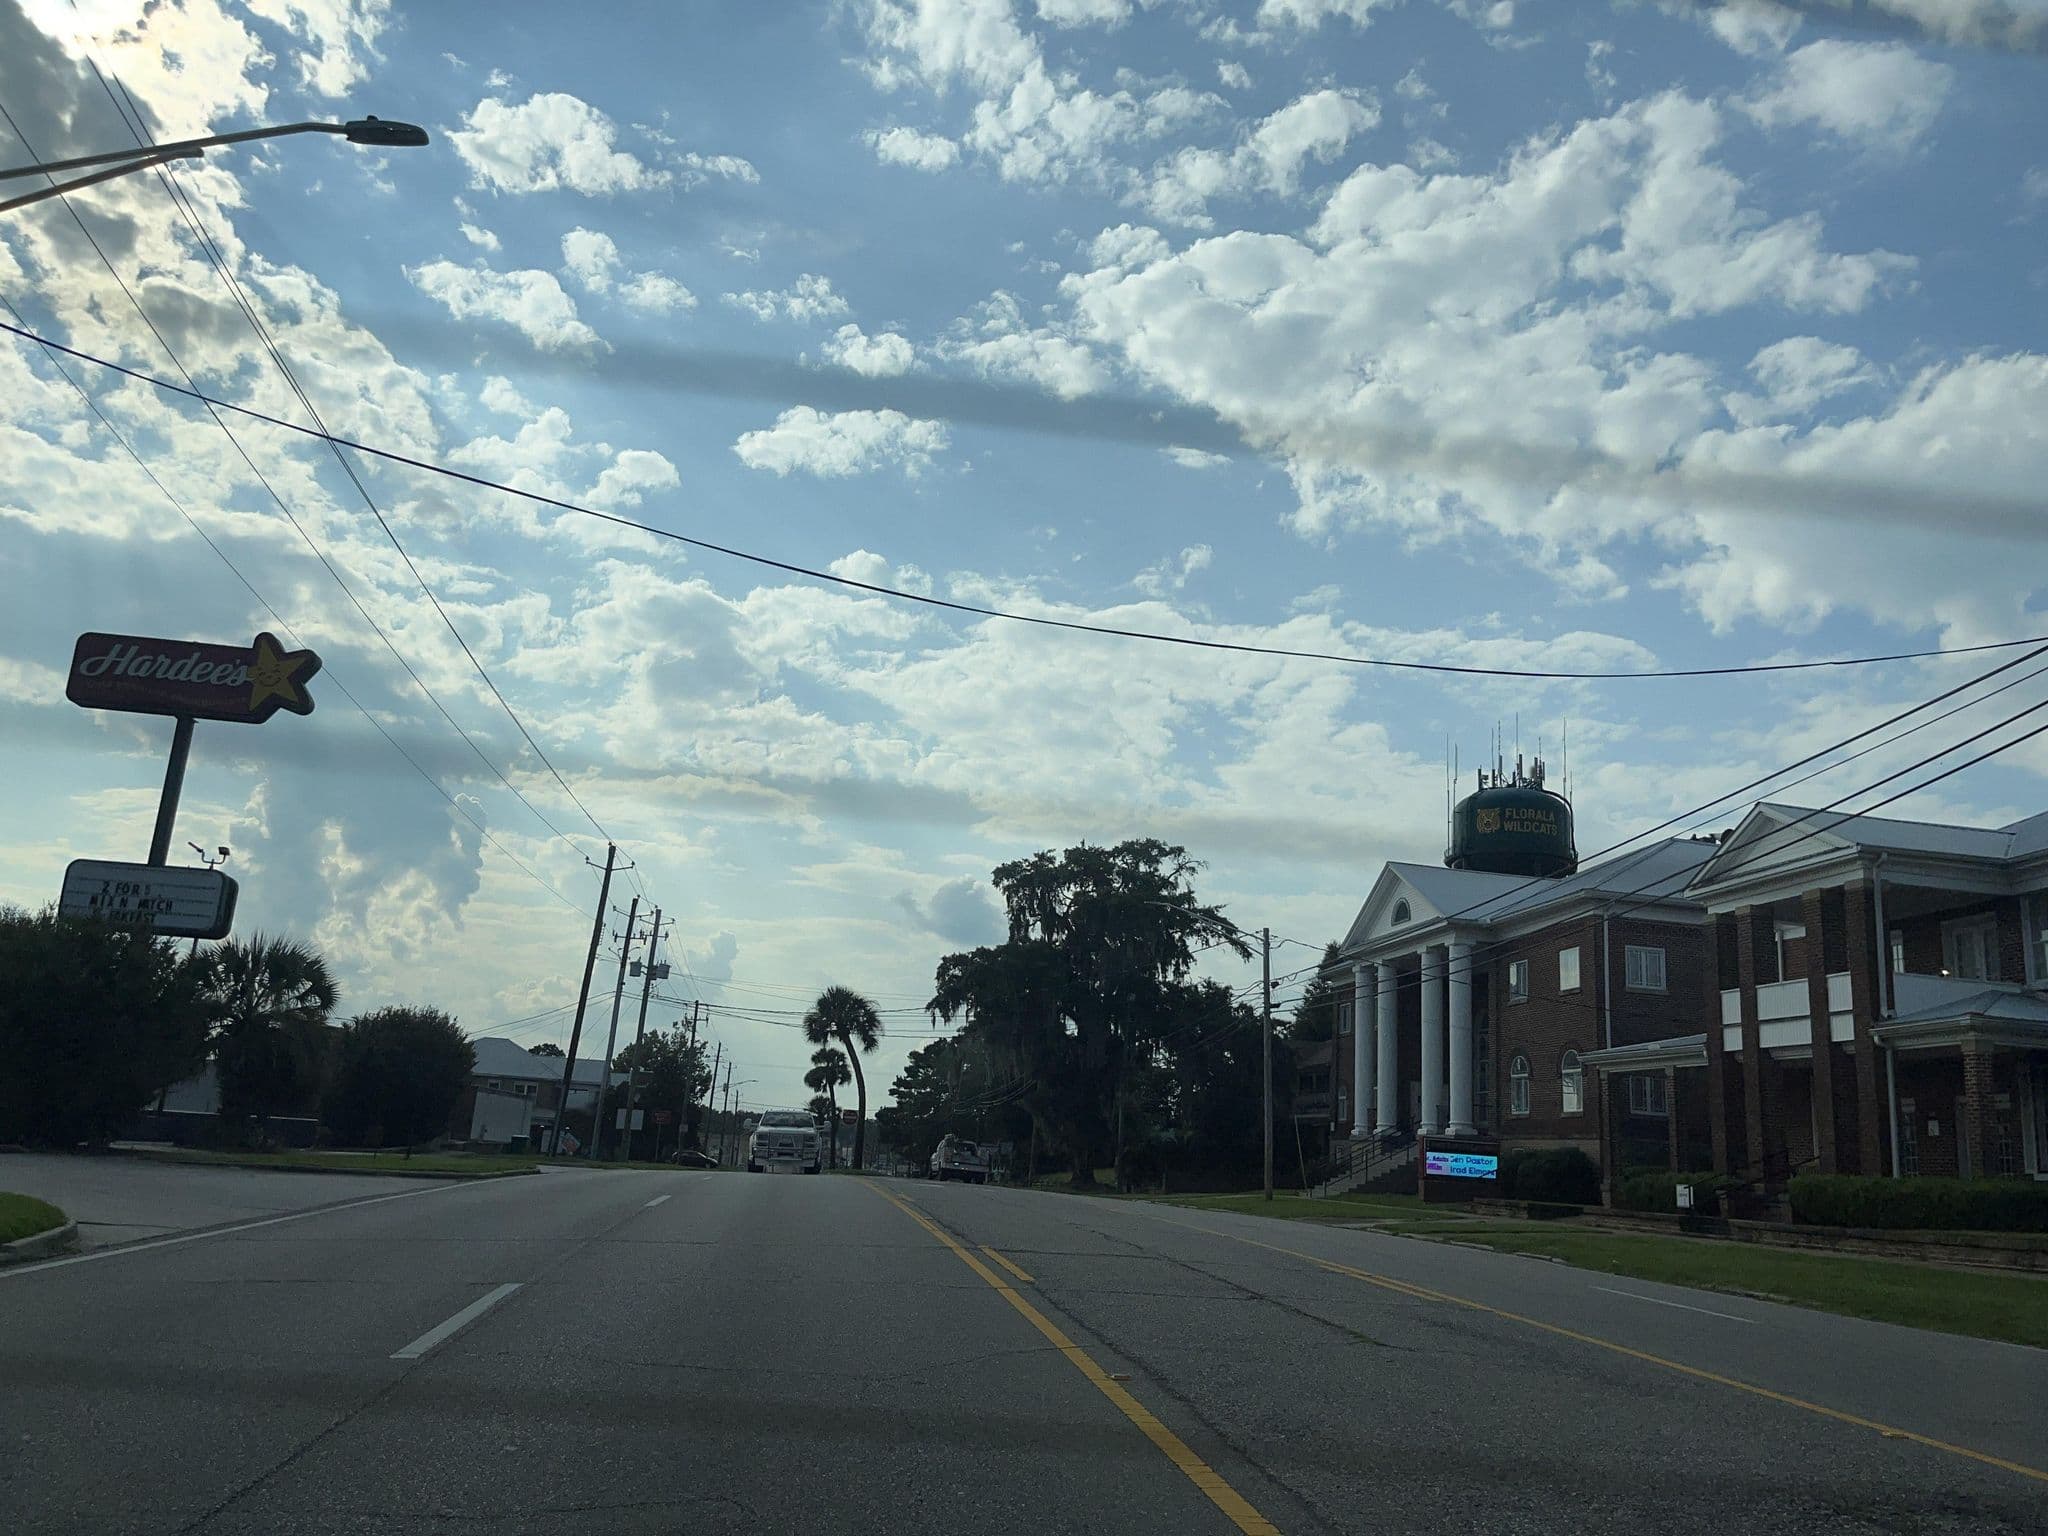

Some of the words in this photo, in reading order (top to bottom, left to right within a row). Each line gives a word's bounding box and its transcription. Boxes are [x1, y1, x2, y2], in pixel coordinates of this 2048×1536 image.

[79, 643, 254, 687] Hardee's
[1504, 808, 1555, 823] FLORALA
[1503, 820, 1558, 836] WILDCATS
[101, 880, 110, 895] 2
[115, 881, 140, 896] FOR
[119, 896, 129, 908] N
[137, 898, 173, 912] MATCH
[1465, 1156, 1494, 1166] Pastor
